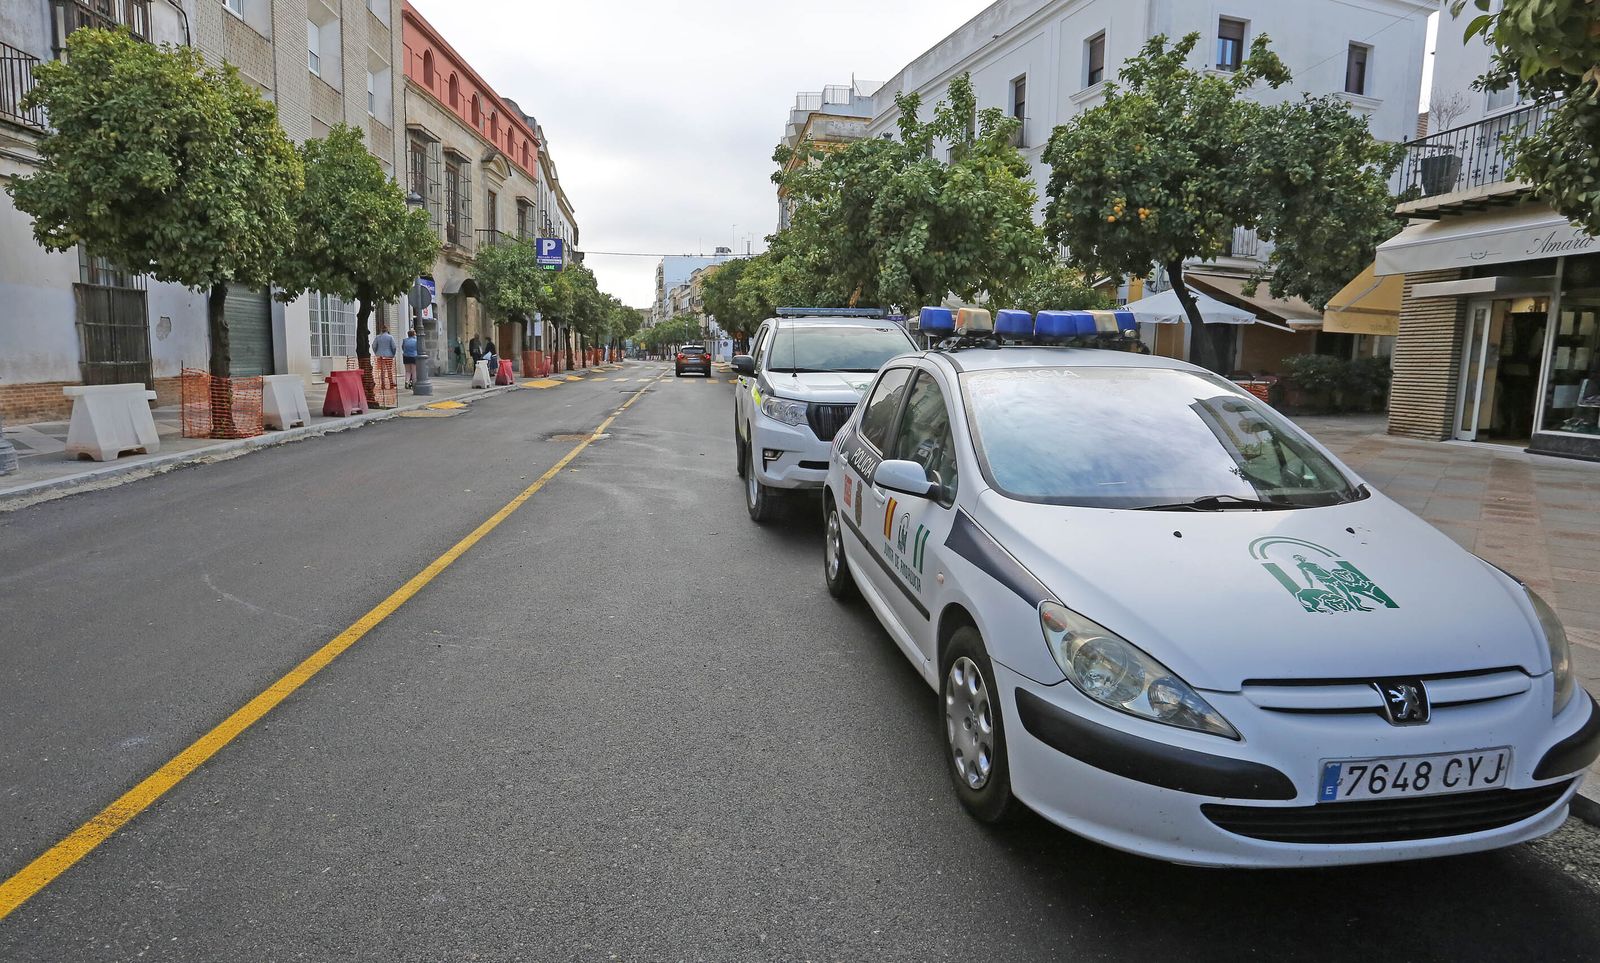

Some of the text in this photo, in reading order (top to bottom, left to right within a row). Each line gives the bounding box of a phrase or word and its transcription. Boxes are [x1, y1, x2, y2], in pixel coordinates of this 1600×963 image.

[543, 239, 556, 255] P
[850, 447, 877, 479] POLICIA
[895, 553, 900, 570] DE
[1344, 753, 1504, 796] 7648 CYJ
[1325, 786, 1334, 795] E
